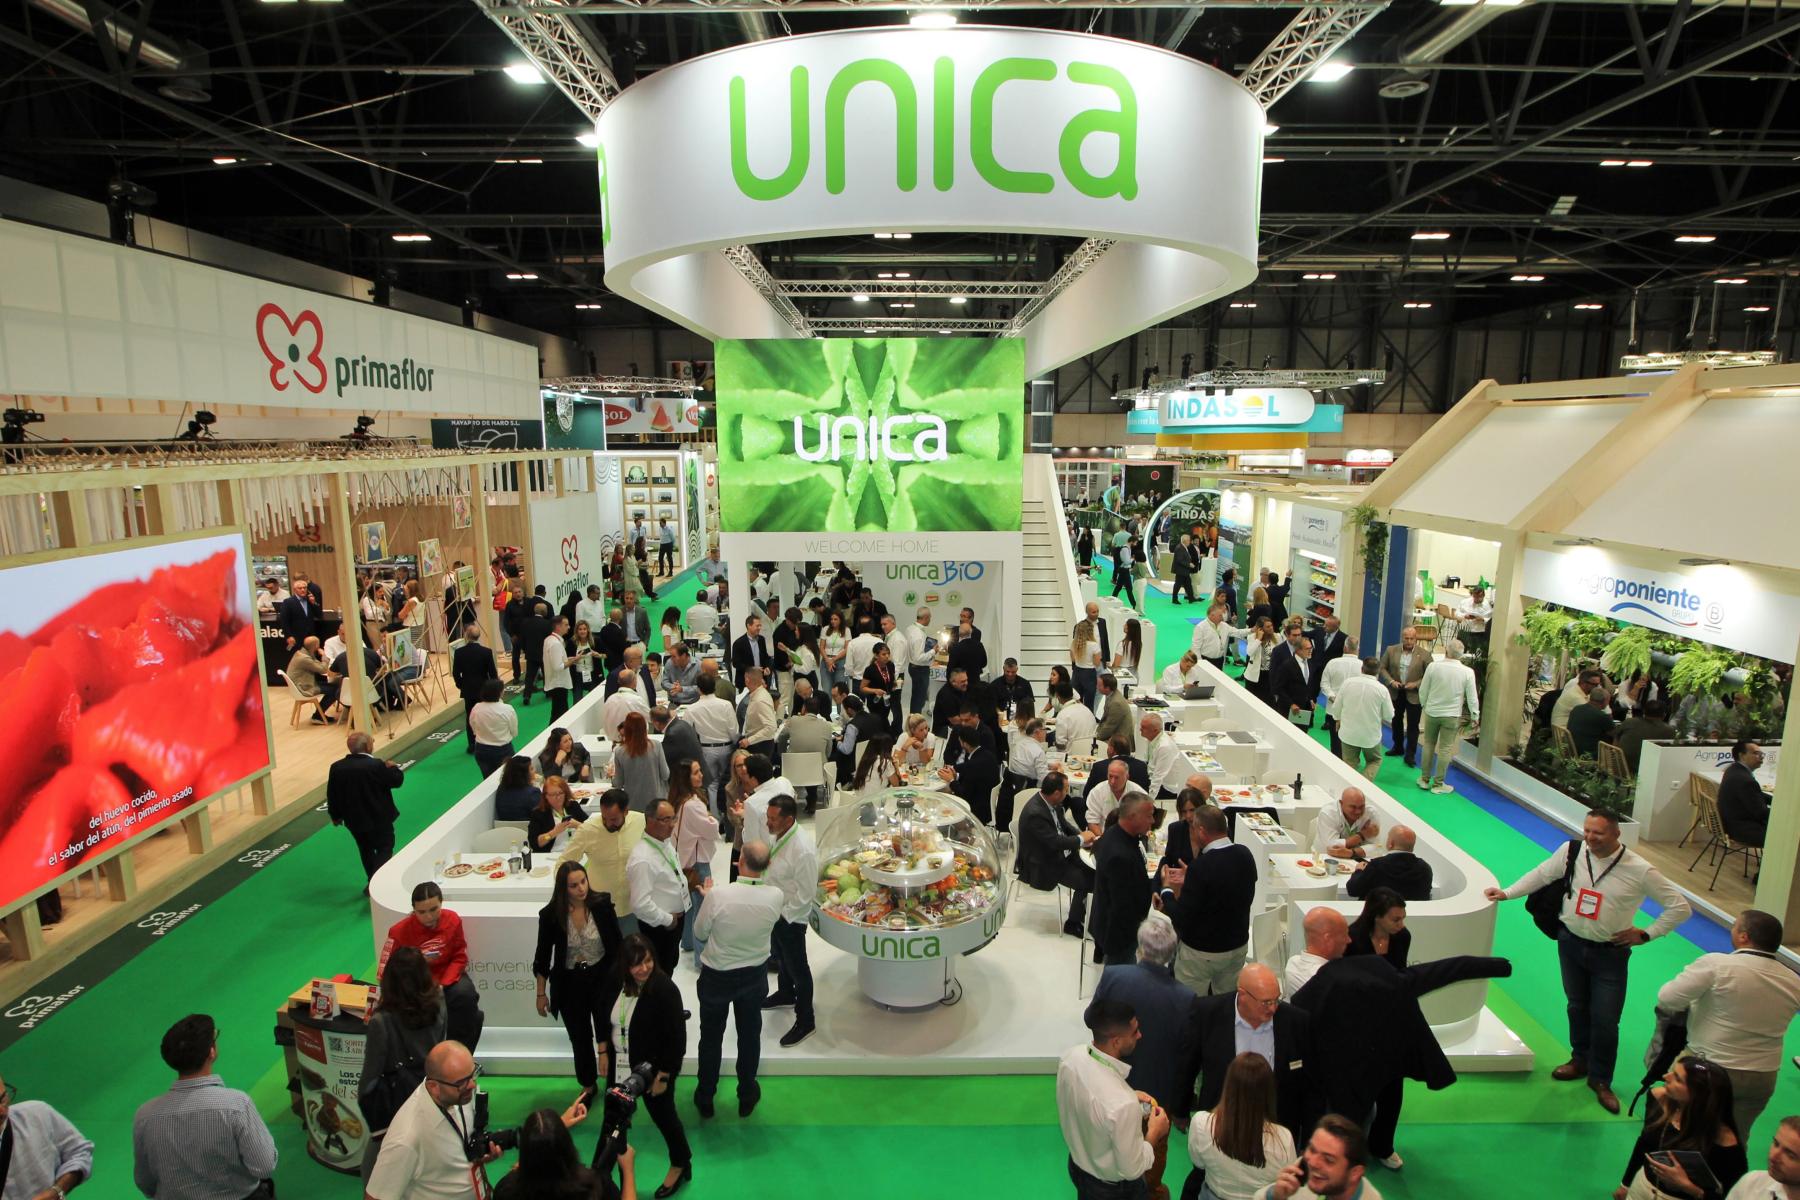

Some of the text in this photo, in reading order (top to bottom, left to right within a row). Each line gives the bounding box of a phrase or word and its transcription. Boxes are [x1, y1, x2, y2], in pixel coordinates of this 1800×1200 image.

[729, 56, 1138, 201] unica
[335, 355, 434, 398] primaflor
[794, 415, 948, 462] unica
[805, 539, 939, 554] WELCOME HOME
[556, 571, 589, 606] primaflor
[48, 785, 193, 866] el sabor del atún, del pimiento asado
[89, 789, 158, 829] del huevo cocido,
[152, 903, 203, 936] primaflor
[862, 933, 941, 959] unica
[478, 978, 536, 991] a casa
[18, 984, 85, 1028] primaflor
[339, 1069, 355, 1078] Las
[332, 1084, 346, 1099] del
